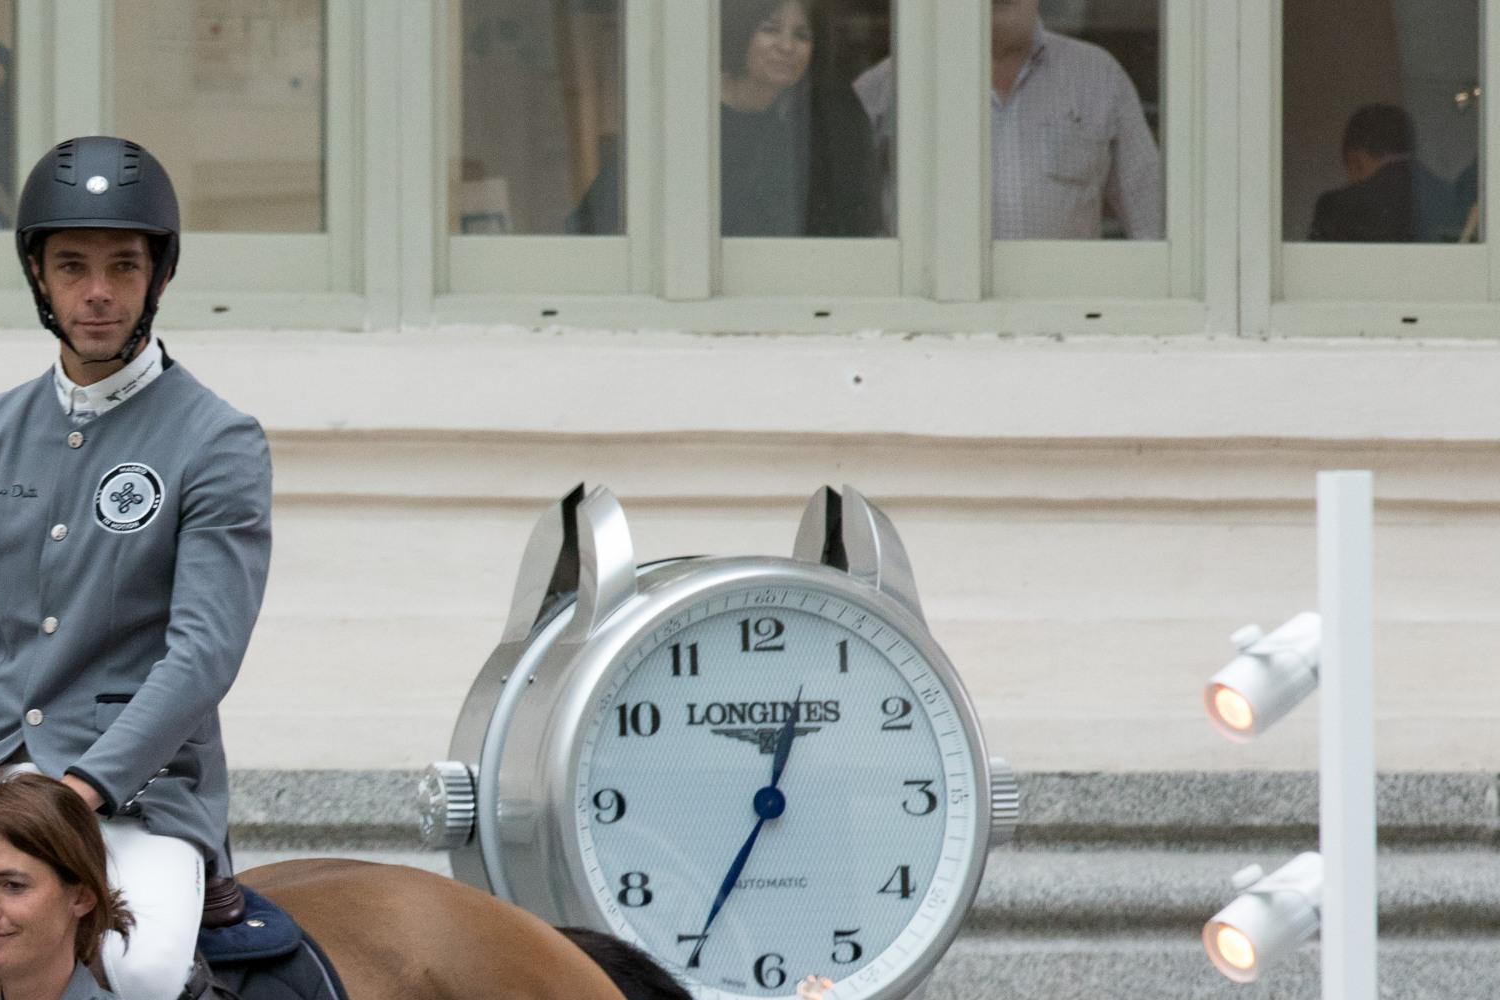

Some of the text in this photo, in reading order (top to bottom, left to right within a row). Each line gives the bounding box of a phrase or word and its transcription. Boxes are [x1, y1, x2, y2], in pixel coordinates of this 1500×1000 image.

[737, 616, 785, 652] 12
[668, 642, 699, 677] 11
[836, 640, 848, 674] 1
[615, 701, 661, 738] 10
[687, 700, 841, 726] LONGINES
[881, 696, 913, 731] 2
[593, 788, 626, 824] 9
[902, 780, 937, 817] 3
[617, 871, 653, 908] 8
[877, 865, 917, 899] 4
[677, 933, 709, 969] 7
[831, 927, 863, 965] 5
[753, 952, 787, 990] 6
